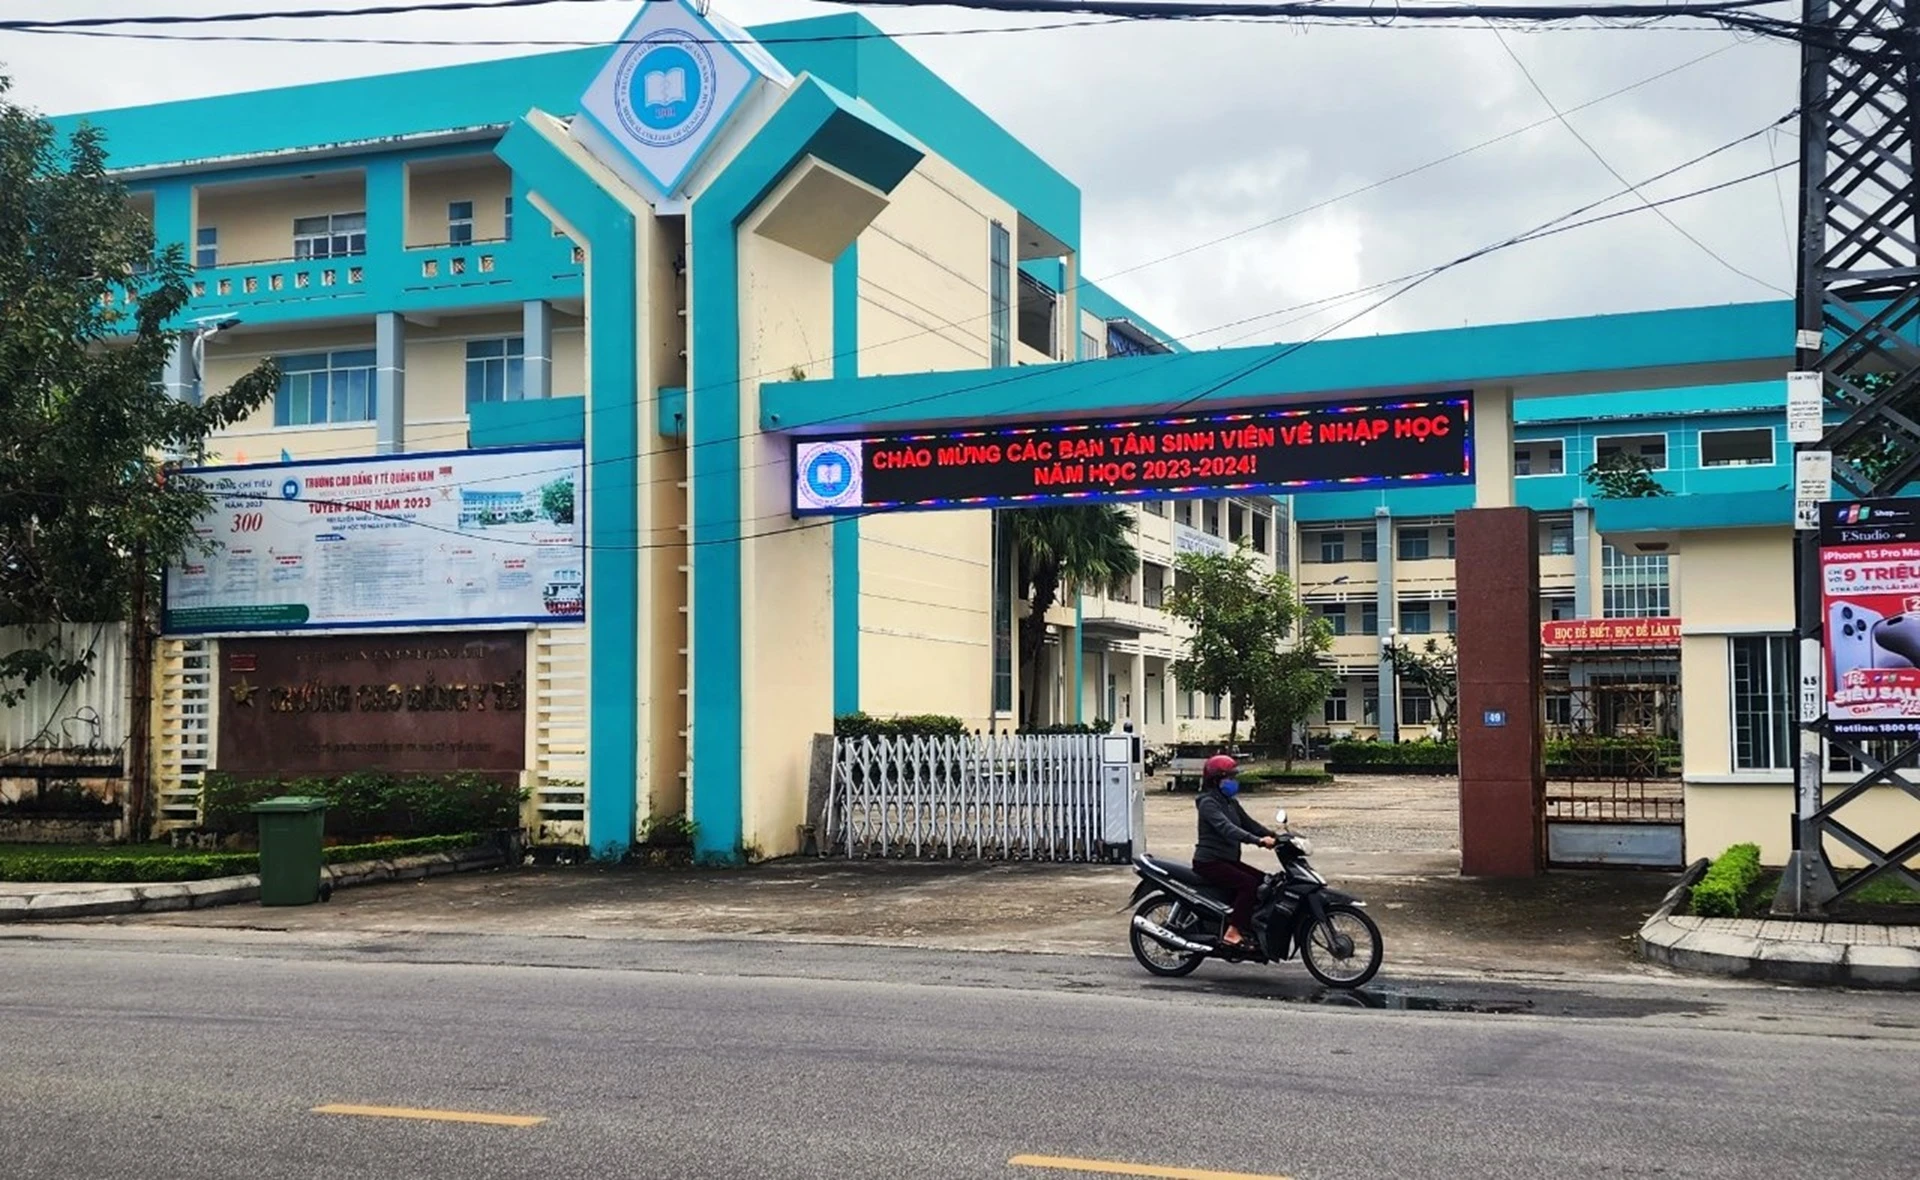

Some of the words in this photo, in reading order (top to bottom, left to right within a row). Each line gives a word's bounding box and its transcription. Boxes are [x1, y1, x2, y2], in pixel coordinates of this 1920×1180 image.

[873, 446, 932, 469] CHÀO
[937, 442, 1001, 466] MỪNG
[1006, 438, 1052, 462] CÁC
[1058, 438, 1104, 463] BẠN
[1110, 432, 1155, 456] TÂN
[1161, 430, 1215, 453] SINH
[1220, 424, 1274, 449] VIÊN
[1319, 418, 1390, 446] NHẬP
[1394, 415, 1450, 443] HỌC
[1034, 462, 1084, 486] NĂM
[1088, 462, 1136, 487] HỌC
[1142, 454, 1257, 480] 2023-2024!
[404, 497, 431, 509] 2023
[230, 512, 263, 533] 300
[1824, 551, 1863, 560] iPhone
[1864, 550, 1879, 559] 15
[1880, 549, 1901, 558] Pro
[1844, 568, 1857, 582] 9
[1861, 563, 1920, 583] TRIỆU
[1554, 627, 1574, 641] HỌC
[1575, 620, 1588, 639] ĐỂ
[1589, 621, 1613, 639] BIẾT,
[1615, 626, 1634, 641] HỌC
[1636, 618, 1650, 637] ĐỂ
[1651, 621, 1671, 637] LÀM
[1835, 724, 1878, 733] Hotline:
[1880, 724, 1905, 732] 1800
